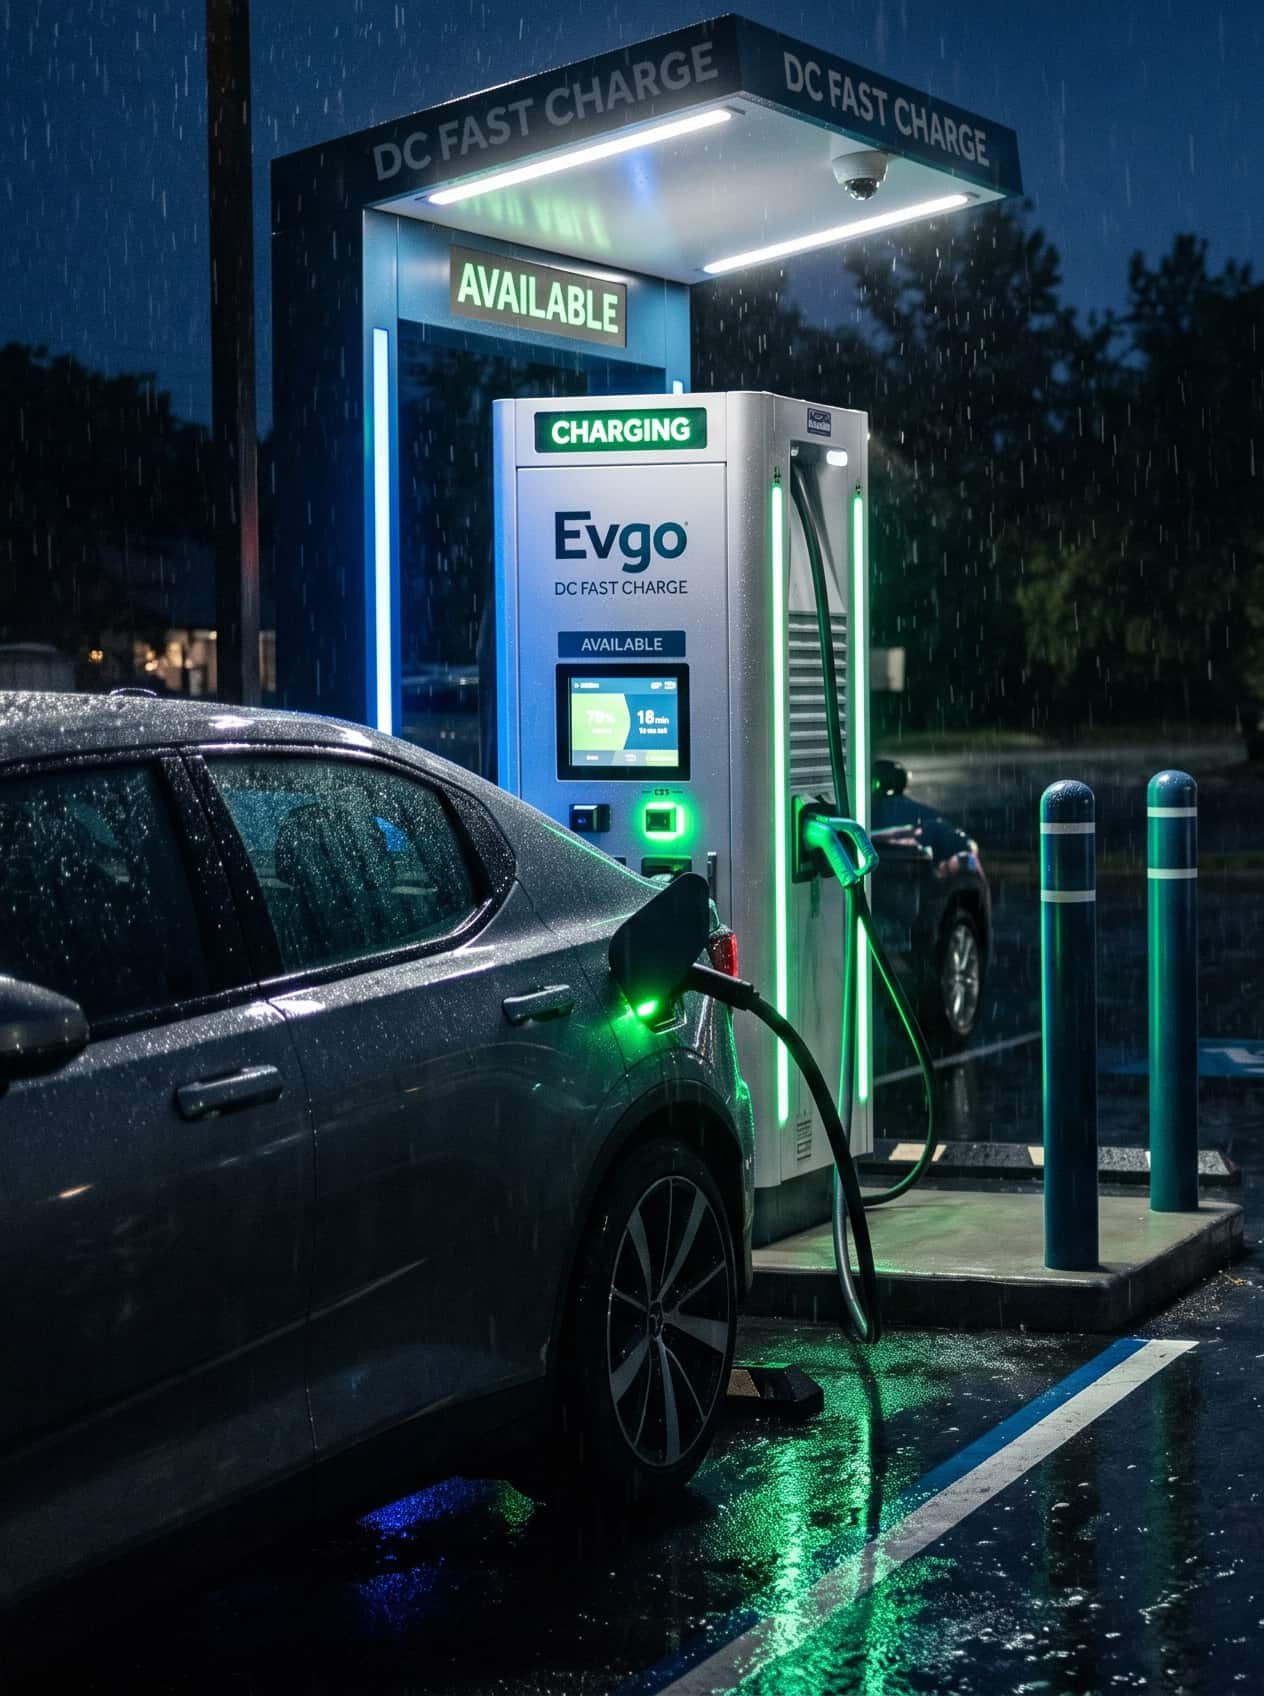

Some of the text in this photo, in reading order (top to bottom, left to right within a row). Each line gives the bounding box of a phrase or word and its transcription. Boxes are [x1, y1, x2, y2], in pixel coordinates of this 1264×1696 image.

[372, 41, 719, 182] DC FAST CHARGE
[783, 51, 990, 168] DC FAST CHARGE
[457, 261, 619, 334] AVAILABLE
[551, 416, 691, 445] CHARGING
[554, 510, 688, 574] Evgo
[554, 579, 688, 596] DC FAST CHARGE
[581, 637, 664, 651] AVAILABLE
